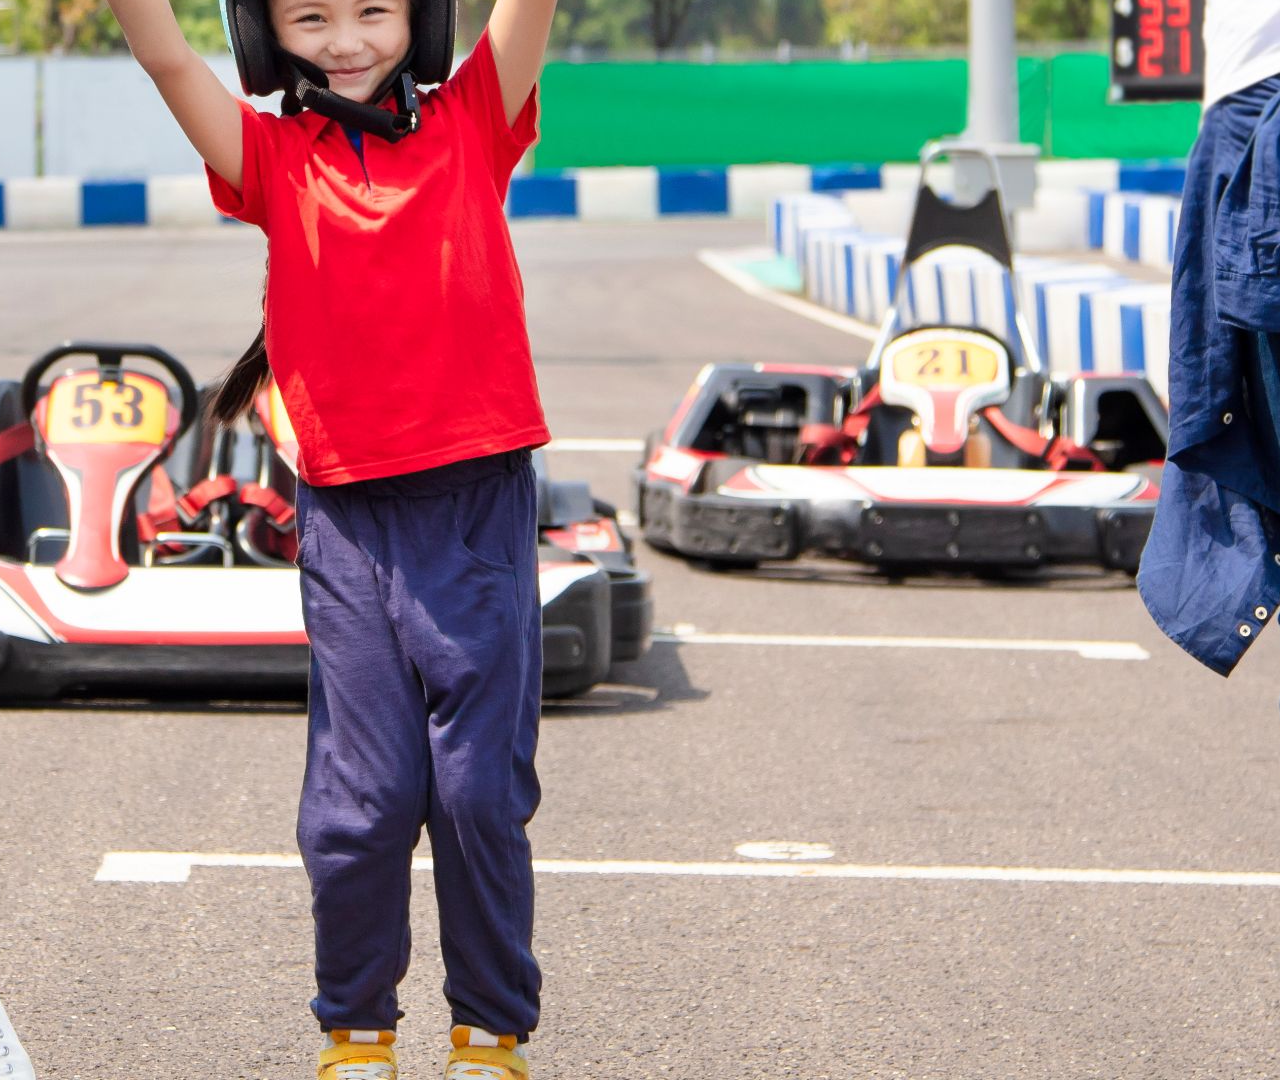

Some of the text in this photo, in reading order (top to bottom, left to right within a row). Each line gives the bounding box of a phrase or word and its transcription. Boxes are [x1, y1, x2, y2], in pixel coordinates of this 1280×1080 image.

[1137, 27, 1192, 78] 21
[918, 348, 970, 375] 21
[71, 383, 144, 428] 53
